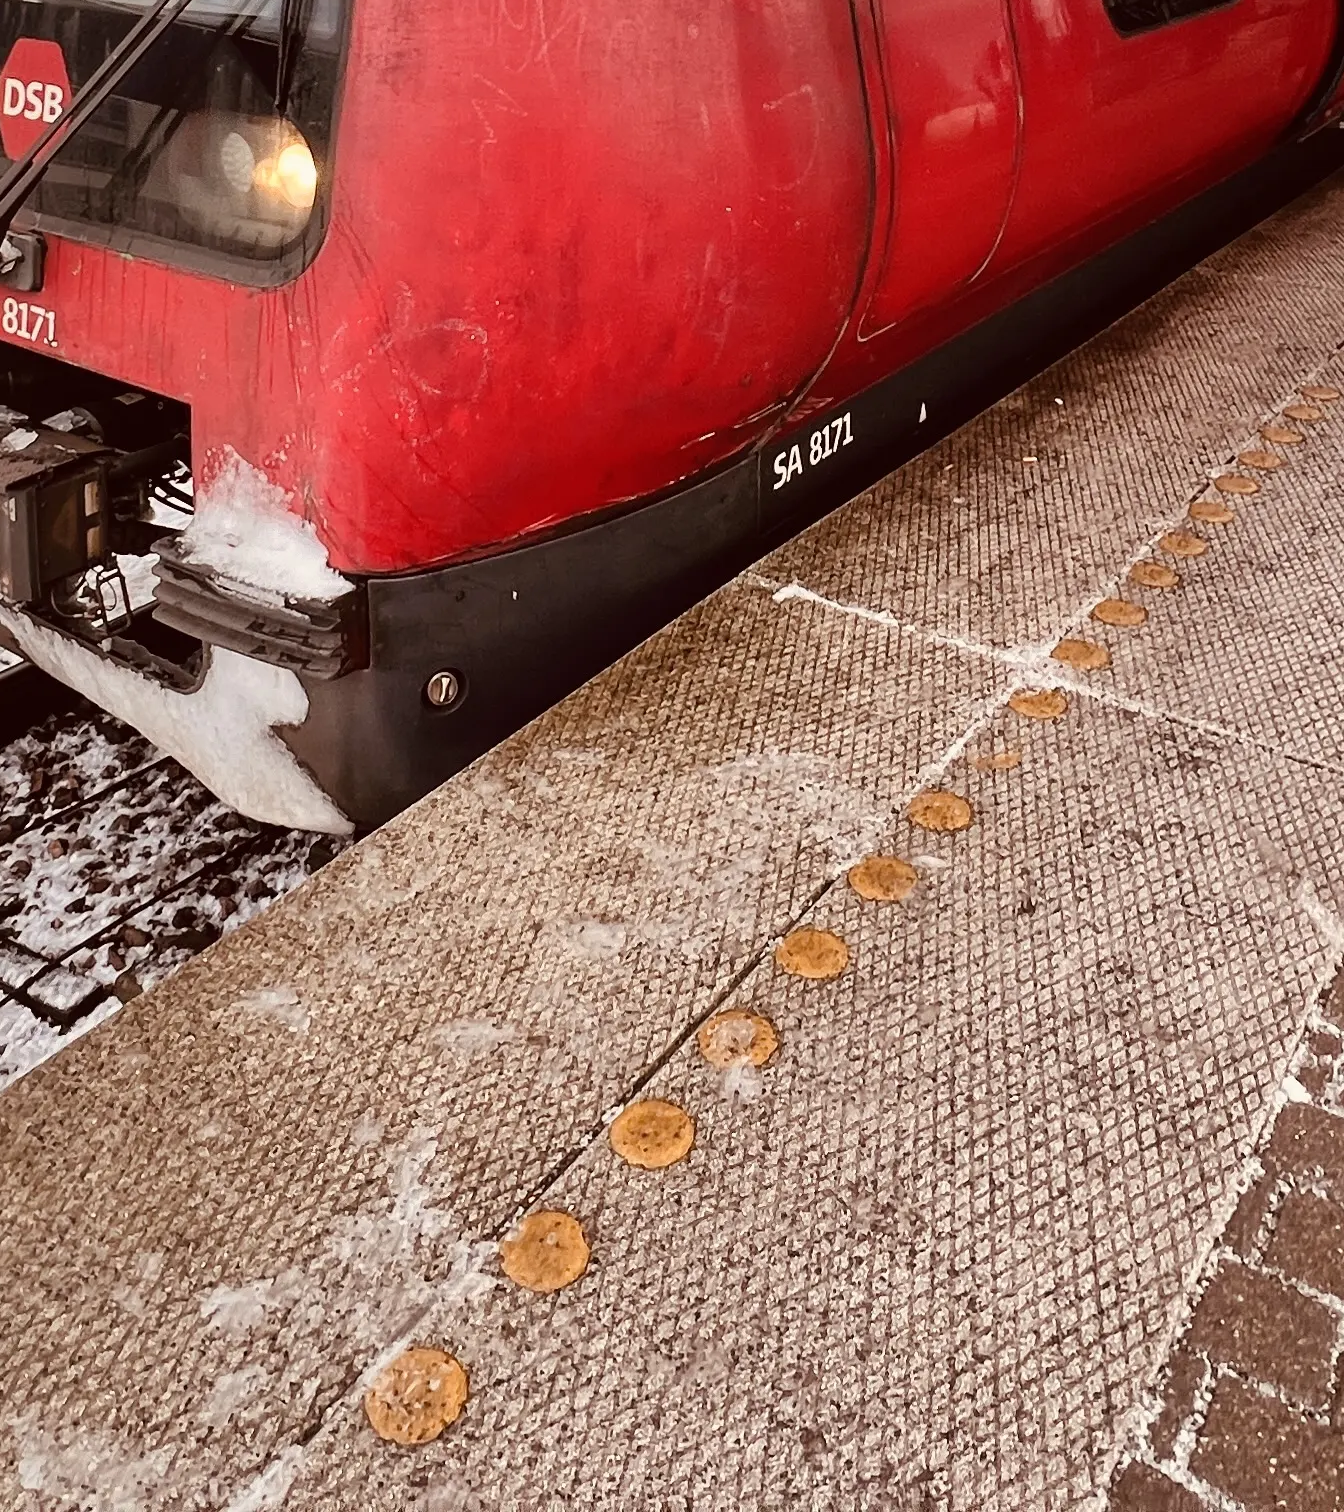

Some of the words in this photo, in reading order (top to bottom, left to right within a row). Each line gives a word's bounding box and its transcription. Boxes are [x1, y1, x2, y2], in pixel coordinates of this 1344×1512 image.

[2, 77, 64, 124] DSB
[2, 297, 58, 347] 8171
[773, 444, 803, 491] SA
[809, 411, 854, 467] 8171
